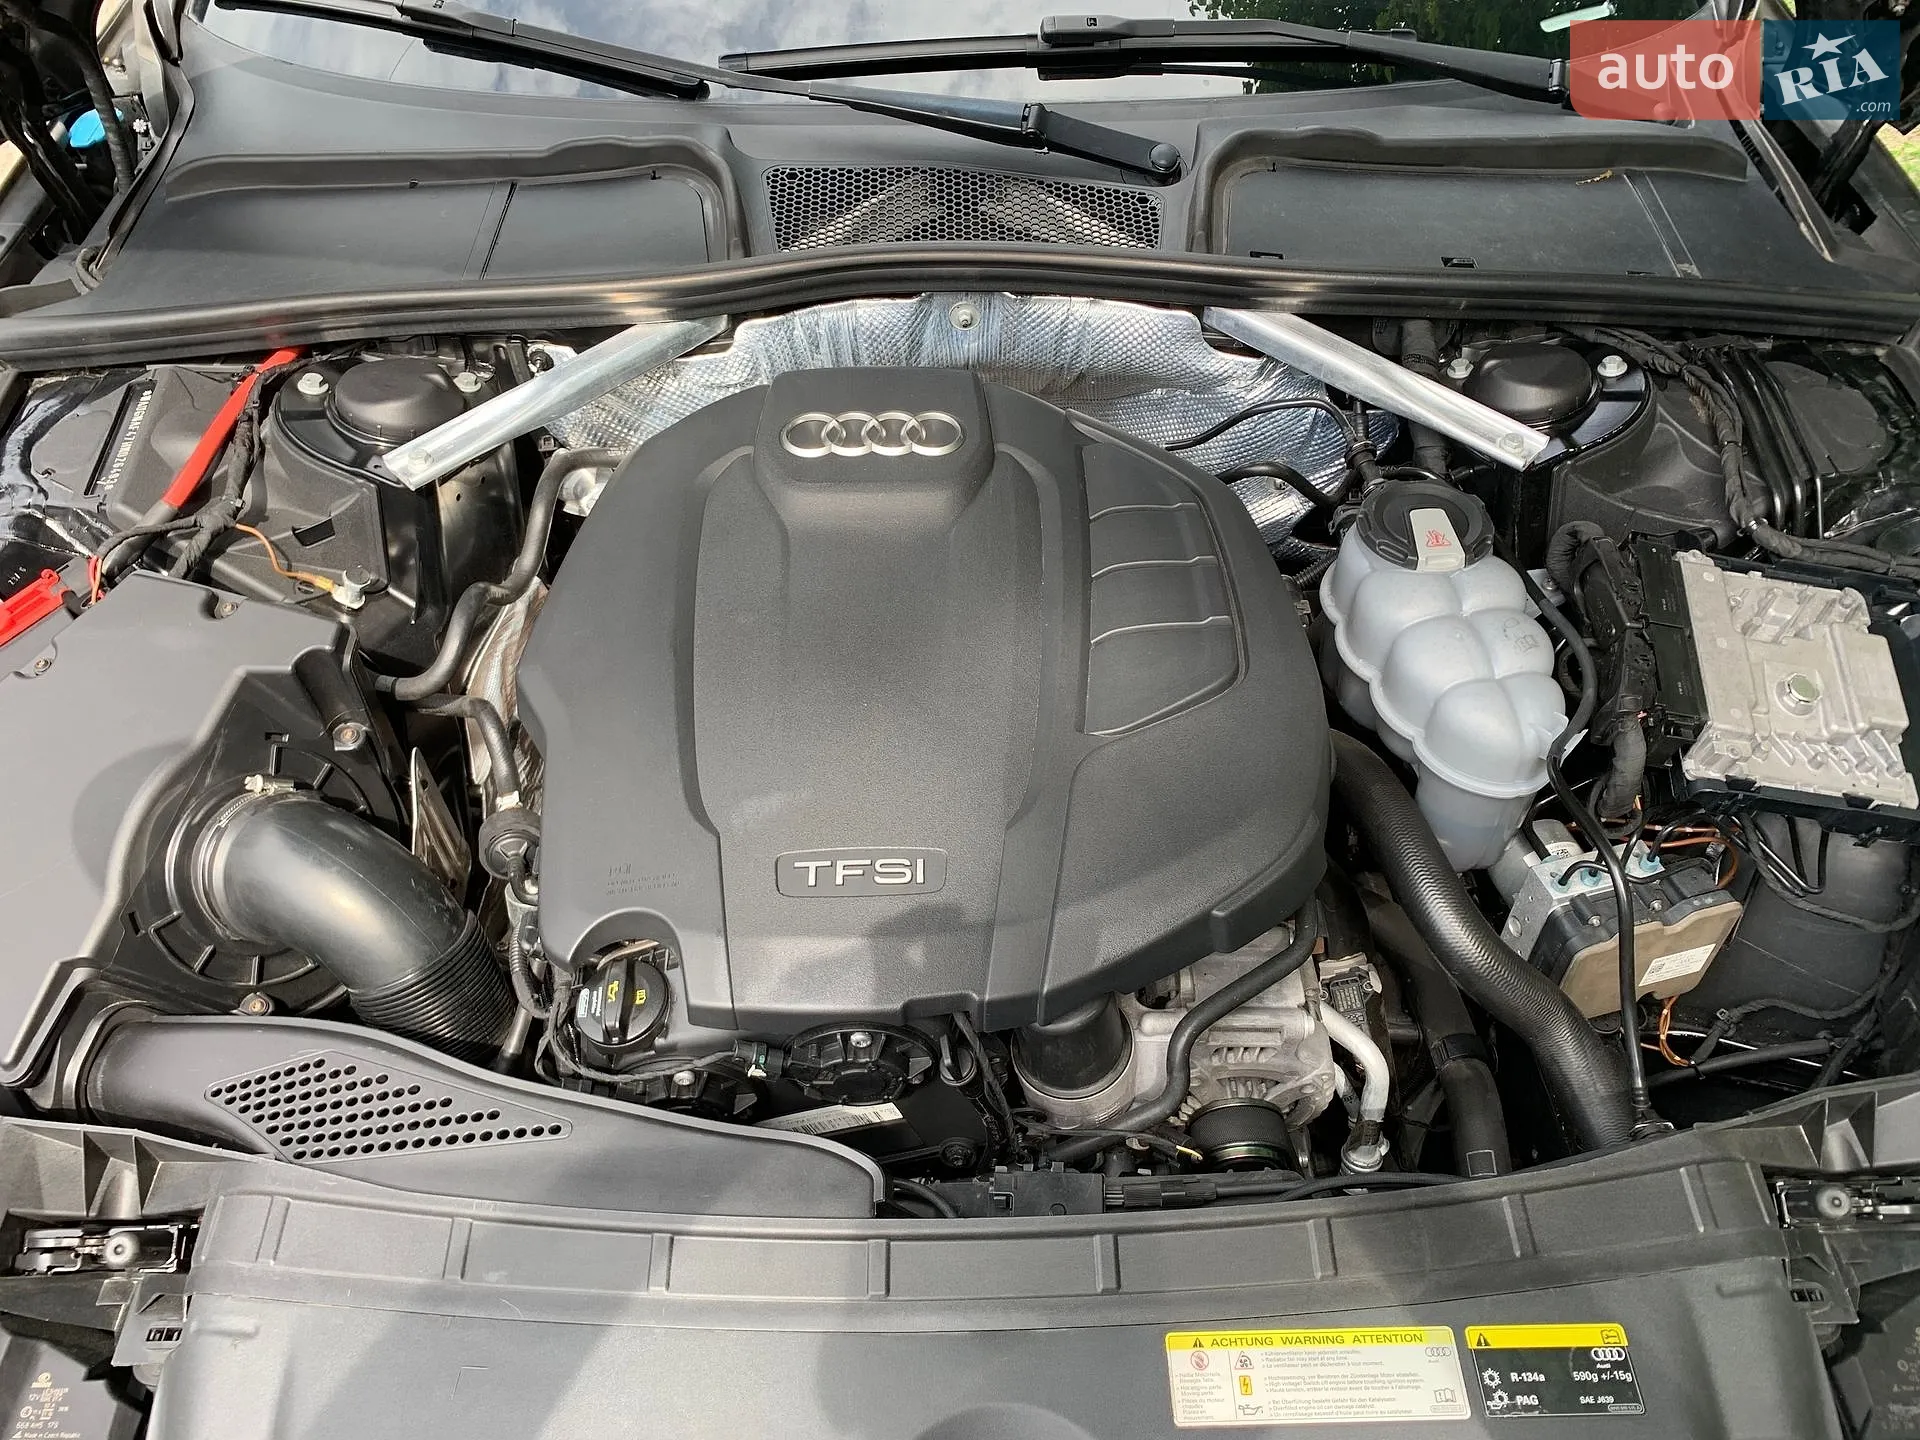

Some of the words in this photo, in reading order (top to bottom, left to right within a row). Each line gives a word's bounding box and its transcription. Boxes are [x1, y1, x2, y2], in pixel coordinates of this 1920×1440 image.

[794, 858, 925, 887] TFSI
[1210, 1335, 1274, 1347] ACHTUNG
[1281, 1334, 1345, 1346] WARNING
[1352, 1333, 1423, 1344] ATTENTION
[1510, 1372, 1546, 1383] R-134a
[1573, 1371, 1599, 1384] 590g
[1601, 1371, 1633, 1383] +/-15g
[1516, 1395, 1539, 1406] PAG
[1580, 1396, 1596, 1404] SAE
